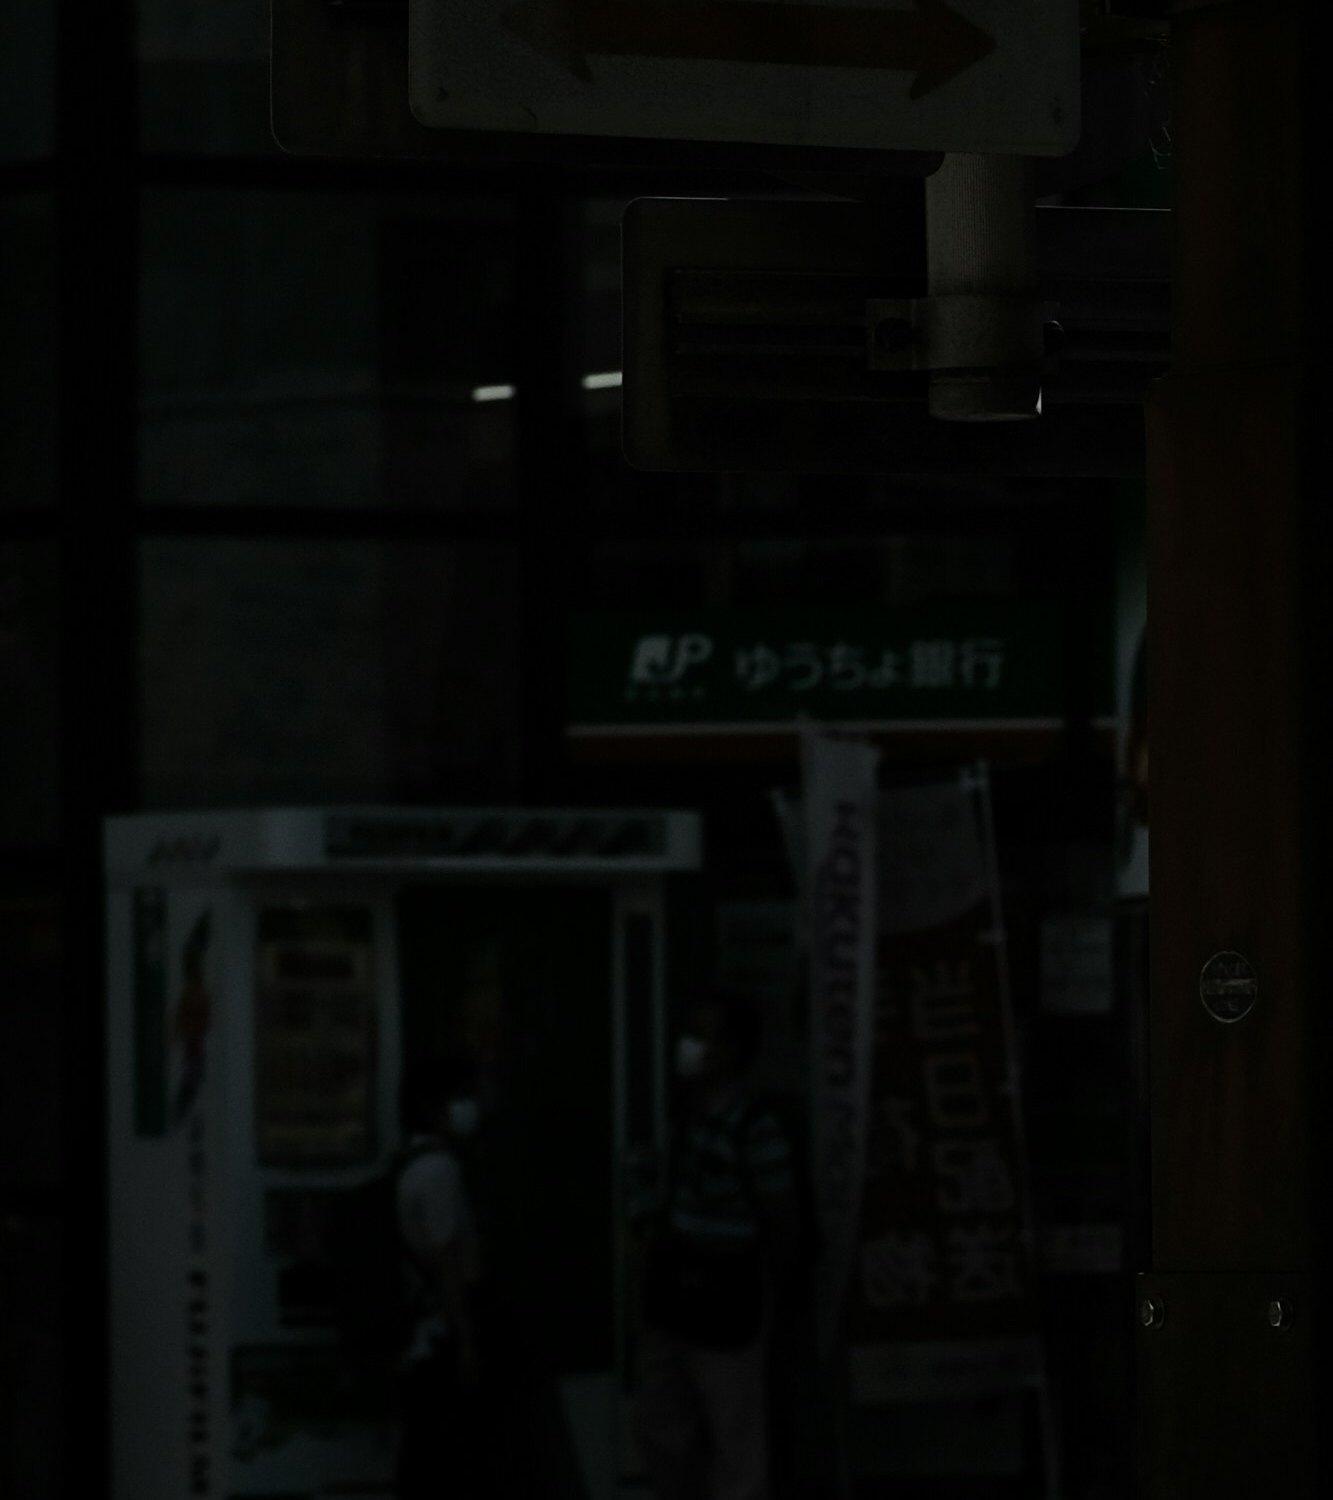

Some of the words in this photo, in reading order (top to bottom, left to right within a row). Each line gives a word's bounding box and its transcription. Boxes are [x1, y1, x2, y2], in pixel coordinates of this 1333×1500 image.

[631, 632, 714, 685] JP
[735, 638, 1007, 692] ゆうちょ銀行
